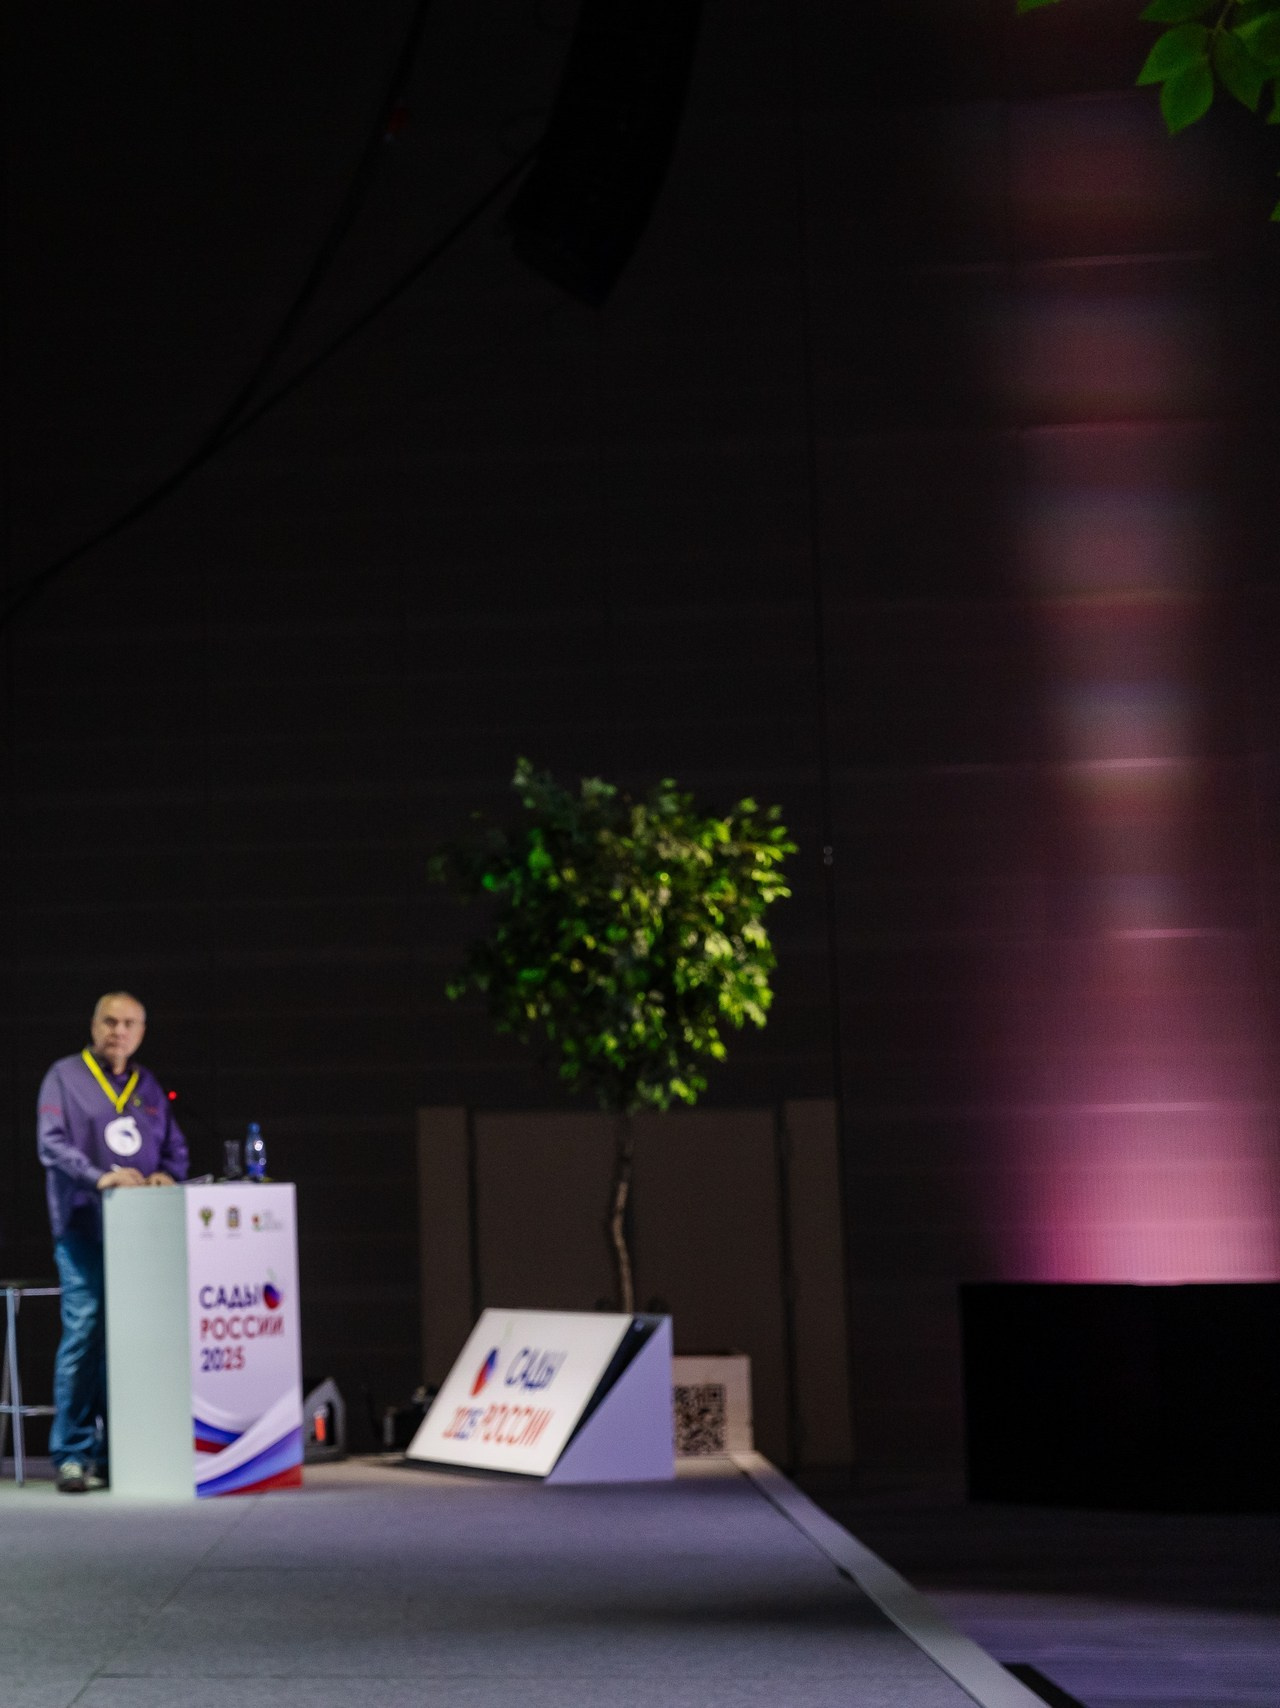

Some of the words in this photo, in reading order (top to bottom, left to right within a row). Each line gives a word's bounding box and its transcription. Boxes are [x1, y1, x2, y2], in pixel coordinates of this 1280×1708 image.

[199, 1284, 261, 1310] САДЫ
[199, 1315, 285, 1342] РОССИИ
[200, 1345, 246, 1373] 2025
